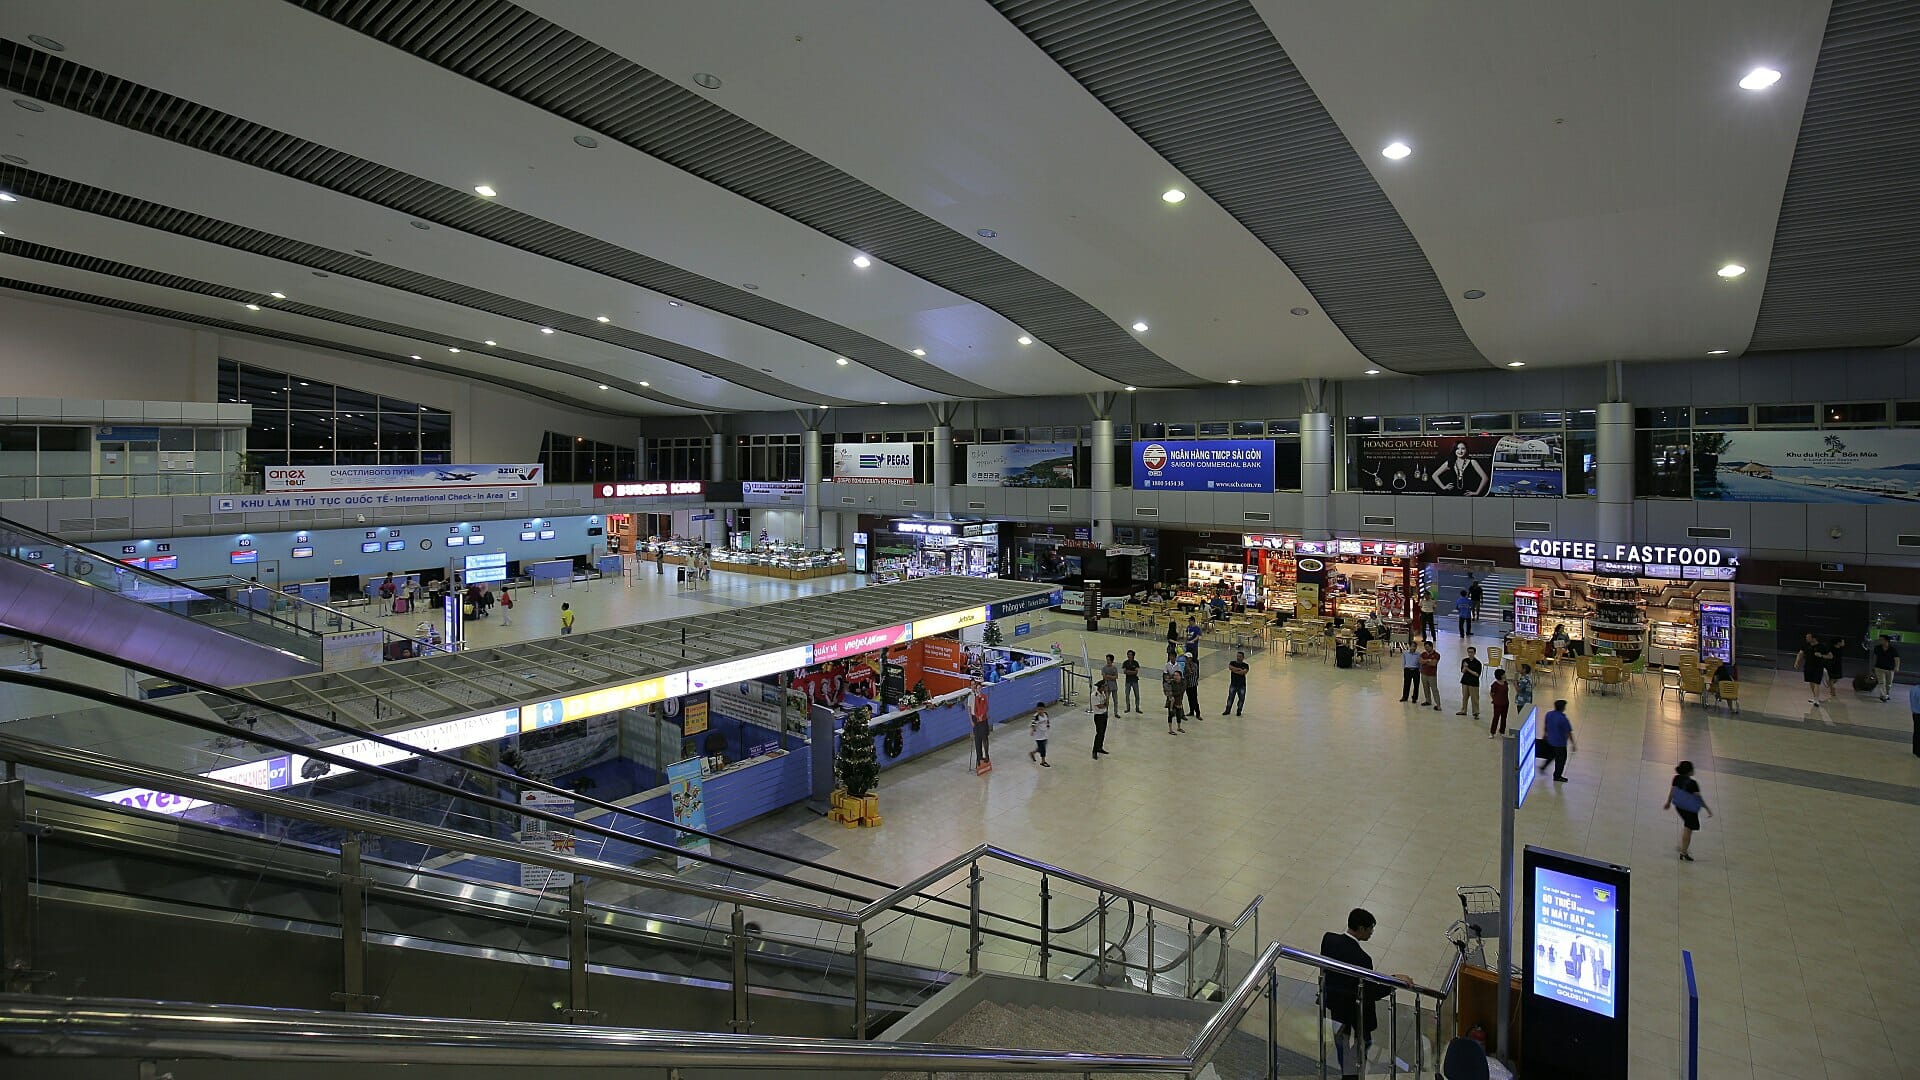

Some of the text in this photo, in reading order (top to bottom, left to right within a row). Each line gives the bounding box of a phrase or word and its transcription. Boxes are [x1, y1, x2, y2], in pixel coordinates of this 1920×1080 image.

[1363, 440, 1394, 448] HOANG
[1410, 440, 1439, 448] PEARL
[1170, 447, 1262, 460] NGÂN HÀNG TMCP SÀI GÒN
[1815, 451, 1829, 459] lịch
[886, 454, 910, 465] PEGAS
[269, 469, 305, 479] anex
[330, 467, 415, 477] СЧАСТЛИВОГО ПУТИ!
[285, 478, 305, 486] tour
[1215, 480, 1262, 488] www.scb.com.vn
[616, 482, 701, 497] BURGER KING
[241, 499, 264, 508] KHU
[267, 496, 291, 508] LÀM
[295, 495, 316, 506] THỦ
[320, 496, 341, 507] TỤC
[345, 493, 373, 504] QUỐC
[376, 492, 389, 503] TẾ
[395, 493, 446, 503] International
[486, 492, 503, 500] Area
[240, 539, 250, 547] 40
[298, 536, 307, 544] 39
[28, 551, 41, 559] 43
[1529, 539, 1596, 560] COFFEE
[1615, 545, 1721, 566] FASTFOOD
[1002, 602, 1019, 614] Phòng
[270, 767, 286, 779] 07
[1555, 896, 1577, 910] TRIỆU
[1551, 908, 1568, 921] MÁY
[1570, 913, 1586, 926] BAY
[1556, 989, 1590, 1003] GOLDSUN
